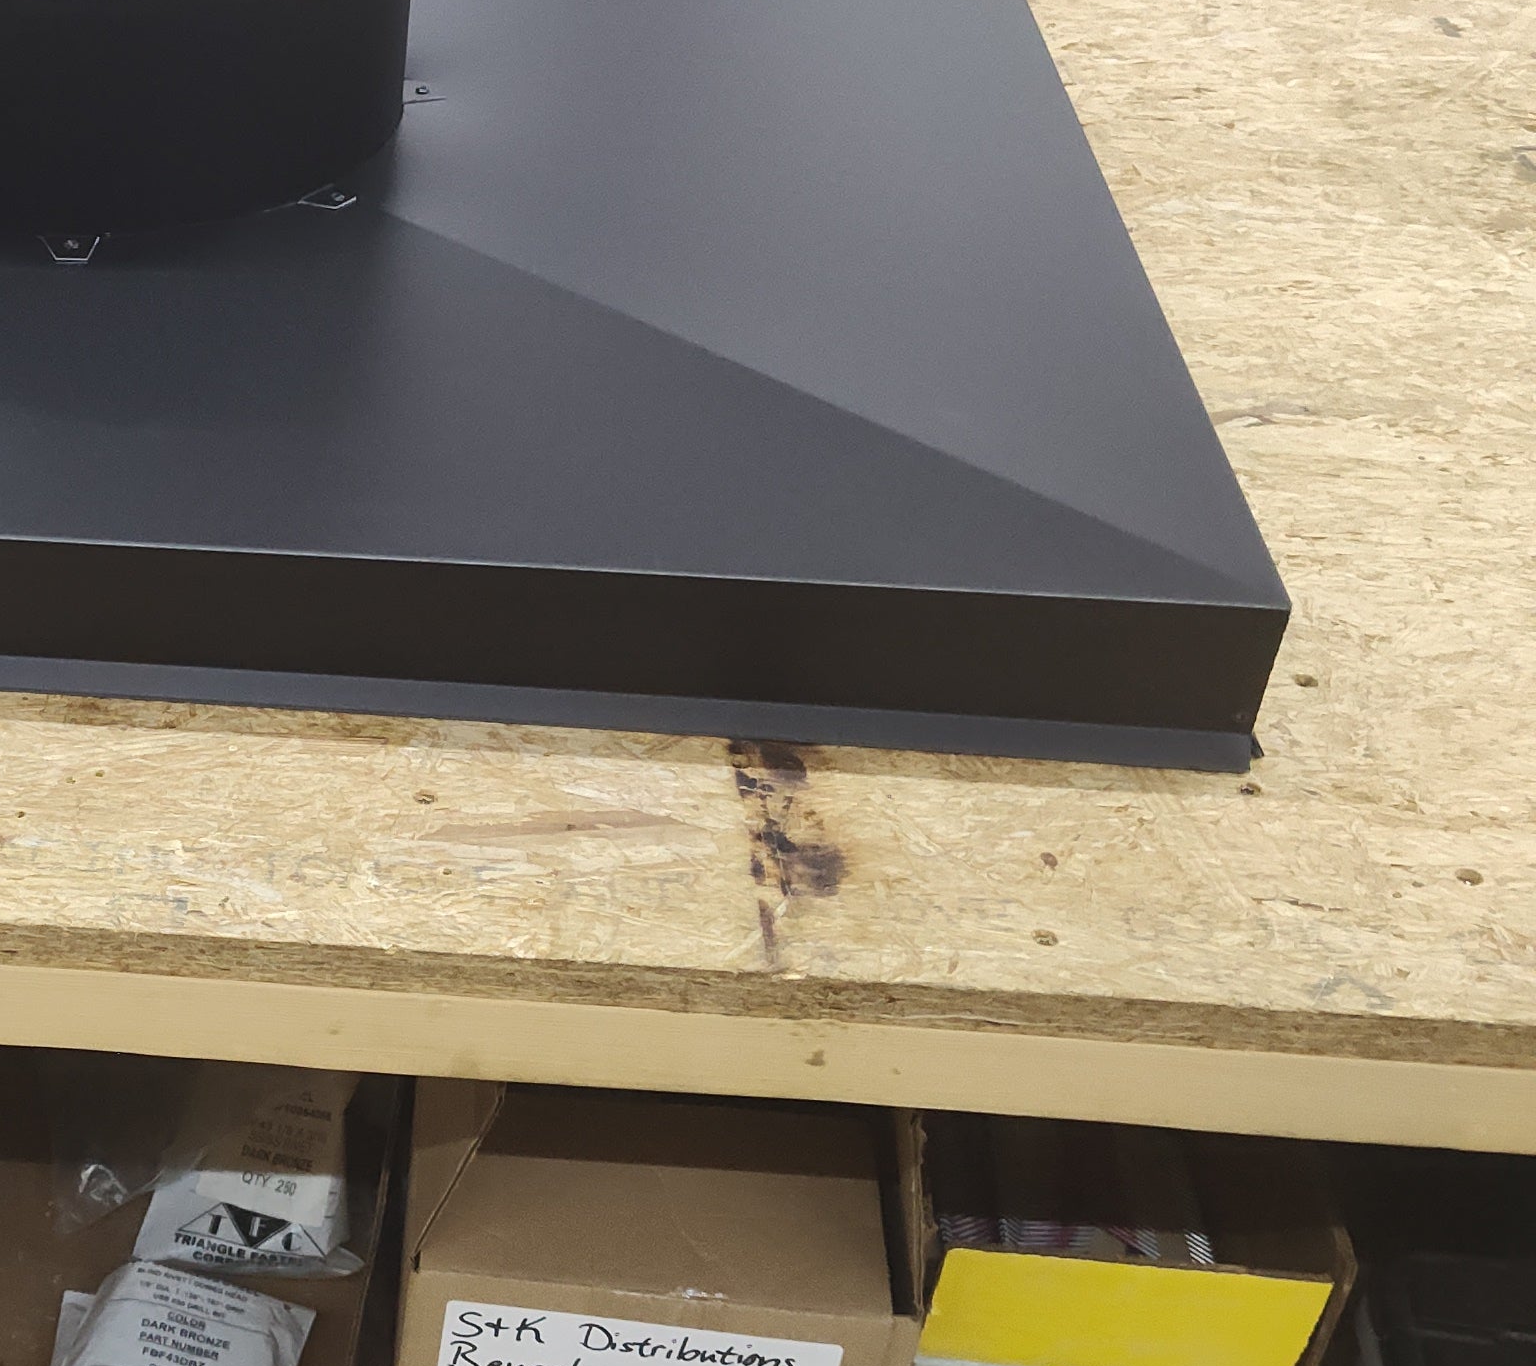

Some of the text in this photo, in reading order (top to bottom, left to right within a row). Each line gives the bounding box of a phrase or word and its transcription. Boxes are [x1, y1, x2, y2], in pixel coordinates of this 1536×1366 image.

[241, 1170, 270, 1188] QTY
[174, 1232, 246, 1259] TRIANGLE
[141, 1317, 231, 1350] DARK BRONZE
[167, 1311, 206, 1329] COLOR
[139, 1331, 219, 1360] PART NUMBER
